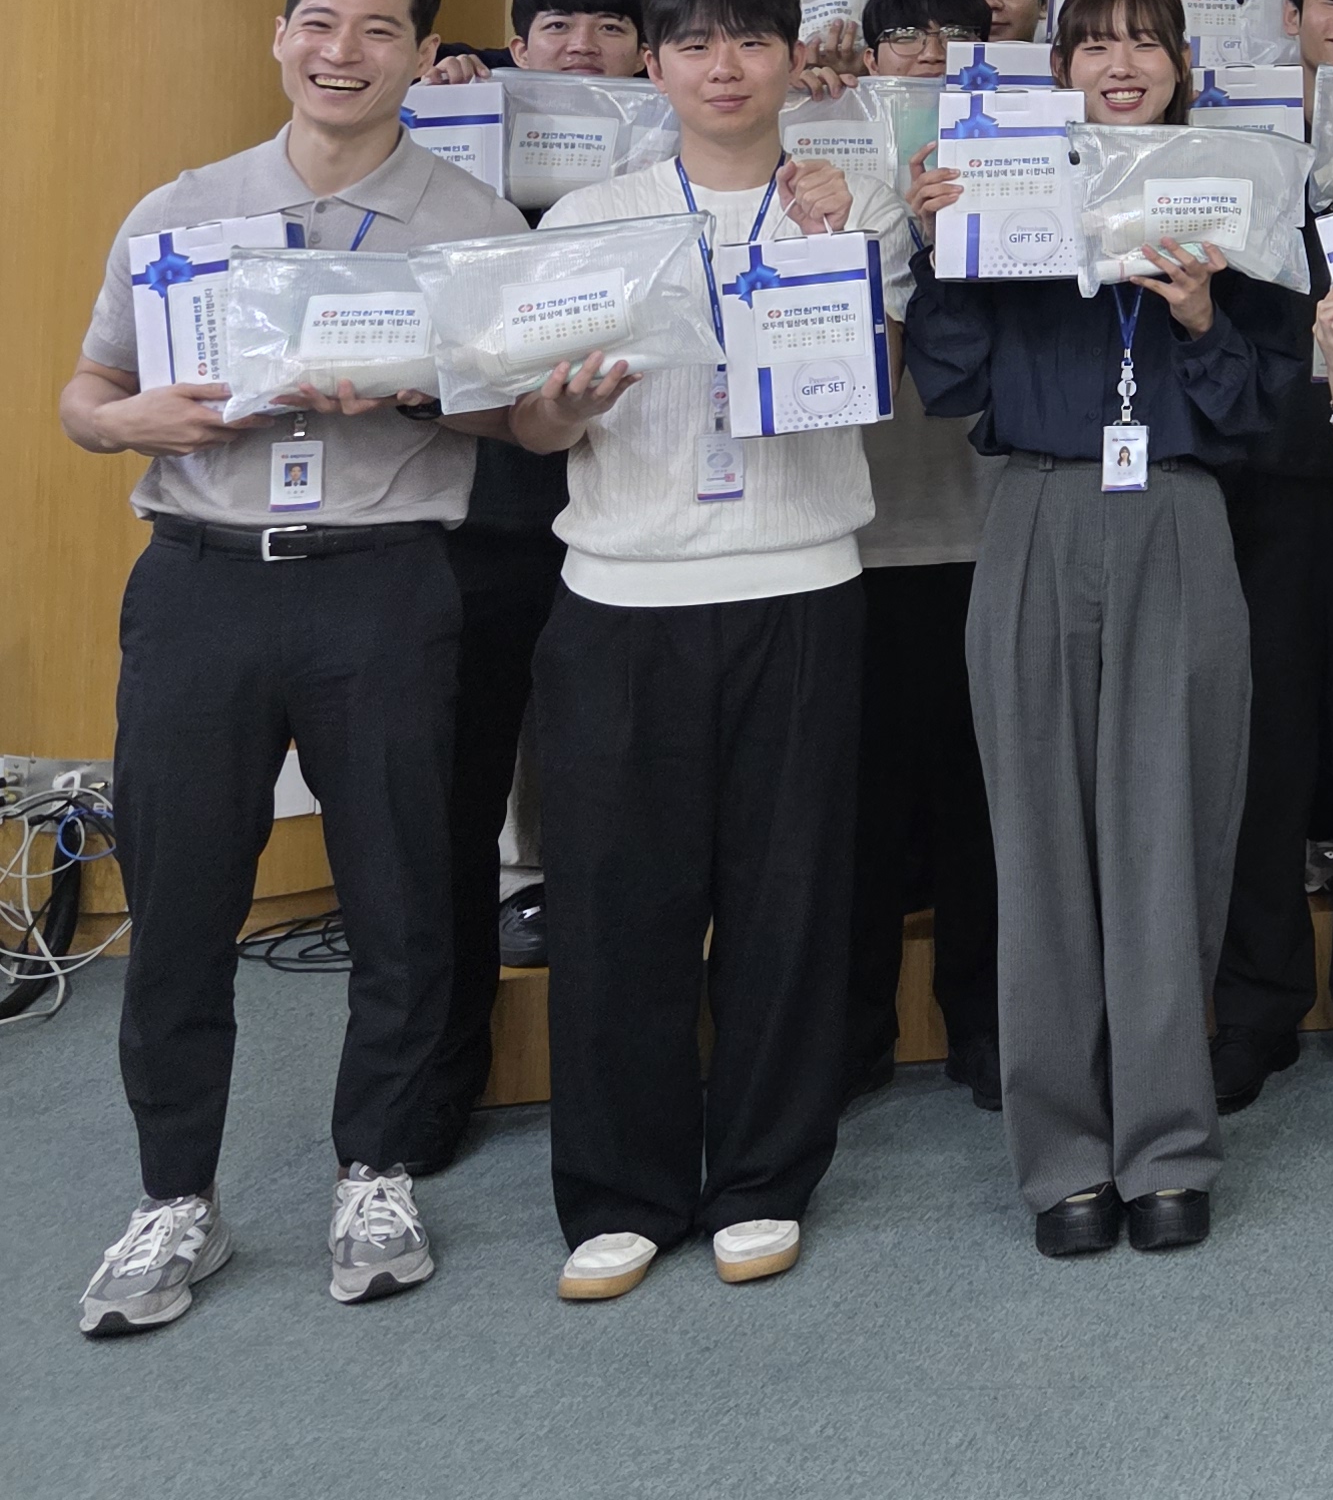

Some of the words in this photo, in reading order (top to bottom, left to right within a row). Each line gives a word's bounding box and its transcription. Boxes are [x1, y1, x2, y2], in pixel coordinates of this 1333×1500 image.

[1009, 233, 1032, 243] GIFT
[1035, 233, 1054, 242] SET
[802, 383, 825, 396] GIFT
[828, 381, 845, 393] SET
